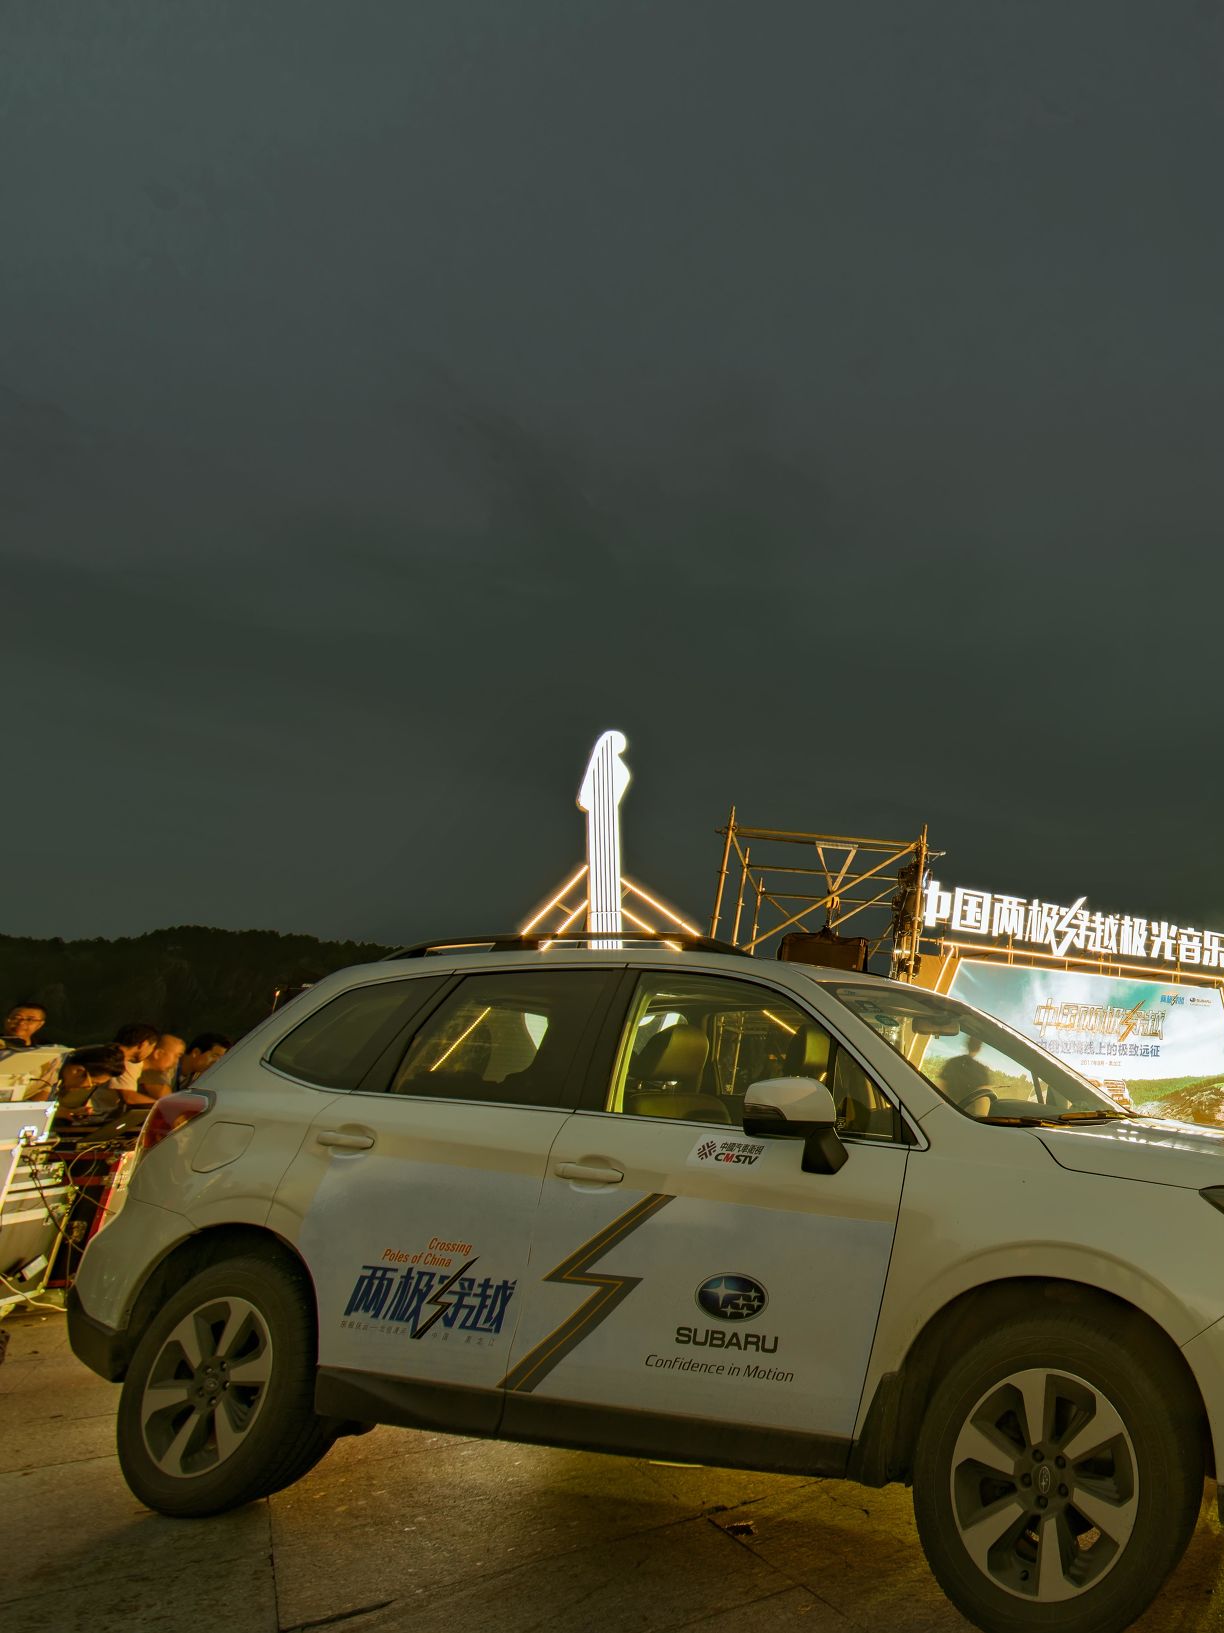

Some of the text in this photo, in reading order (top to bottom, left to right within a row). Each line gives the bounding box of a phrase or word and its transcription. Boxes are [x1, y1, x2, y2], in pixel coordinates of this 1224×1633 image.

[714, 1152, 759, 1165] CMSTV
[382, 1248, 453, 1268] Poles of China
[428, 1238, 473, 1256] Crossing
[344, 1262, 517, 1339] 两极穿越
[675, 1326, 779, 1354] SUBARU
[645, 1354, 795, 1383] Confidence in Motion
